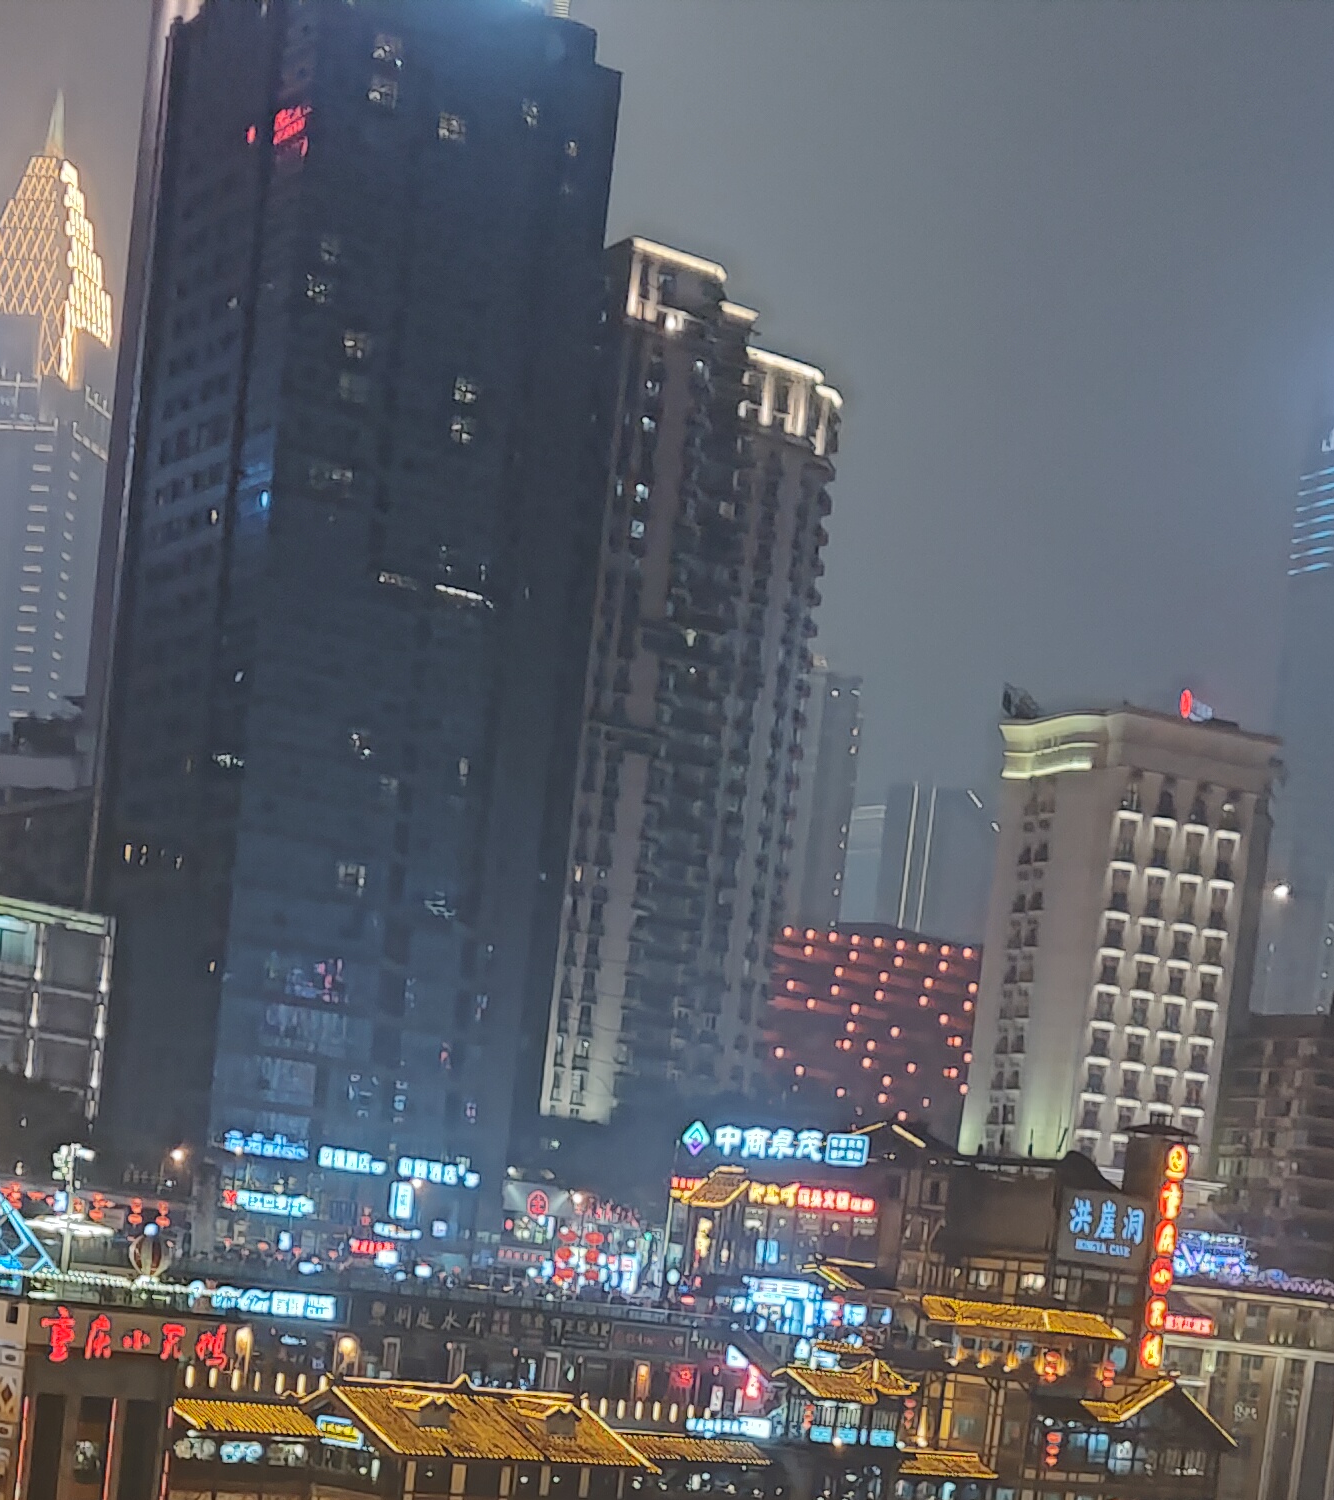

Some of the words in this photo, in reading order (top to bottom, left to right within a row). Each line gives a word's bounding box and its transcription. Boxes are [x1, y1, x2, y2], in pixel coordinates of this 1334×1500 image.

[714, 1125, 825, 1162] 中商卓茂
[1069, 1196, 1145, 1245] 洪崖洞
